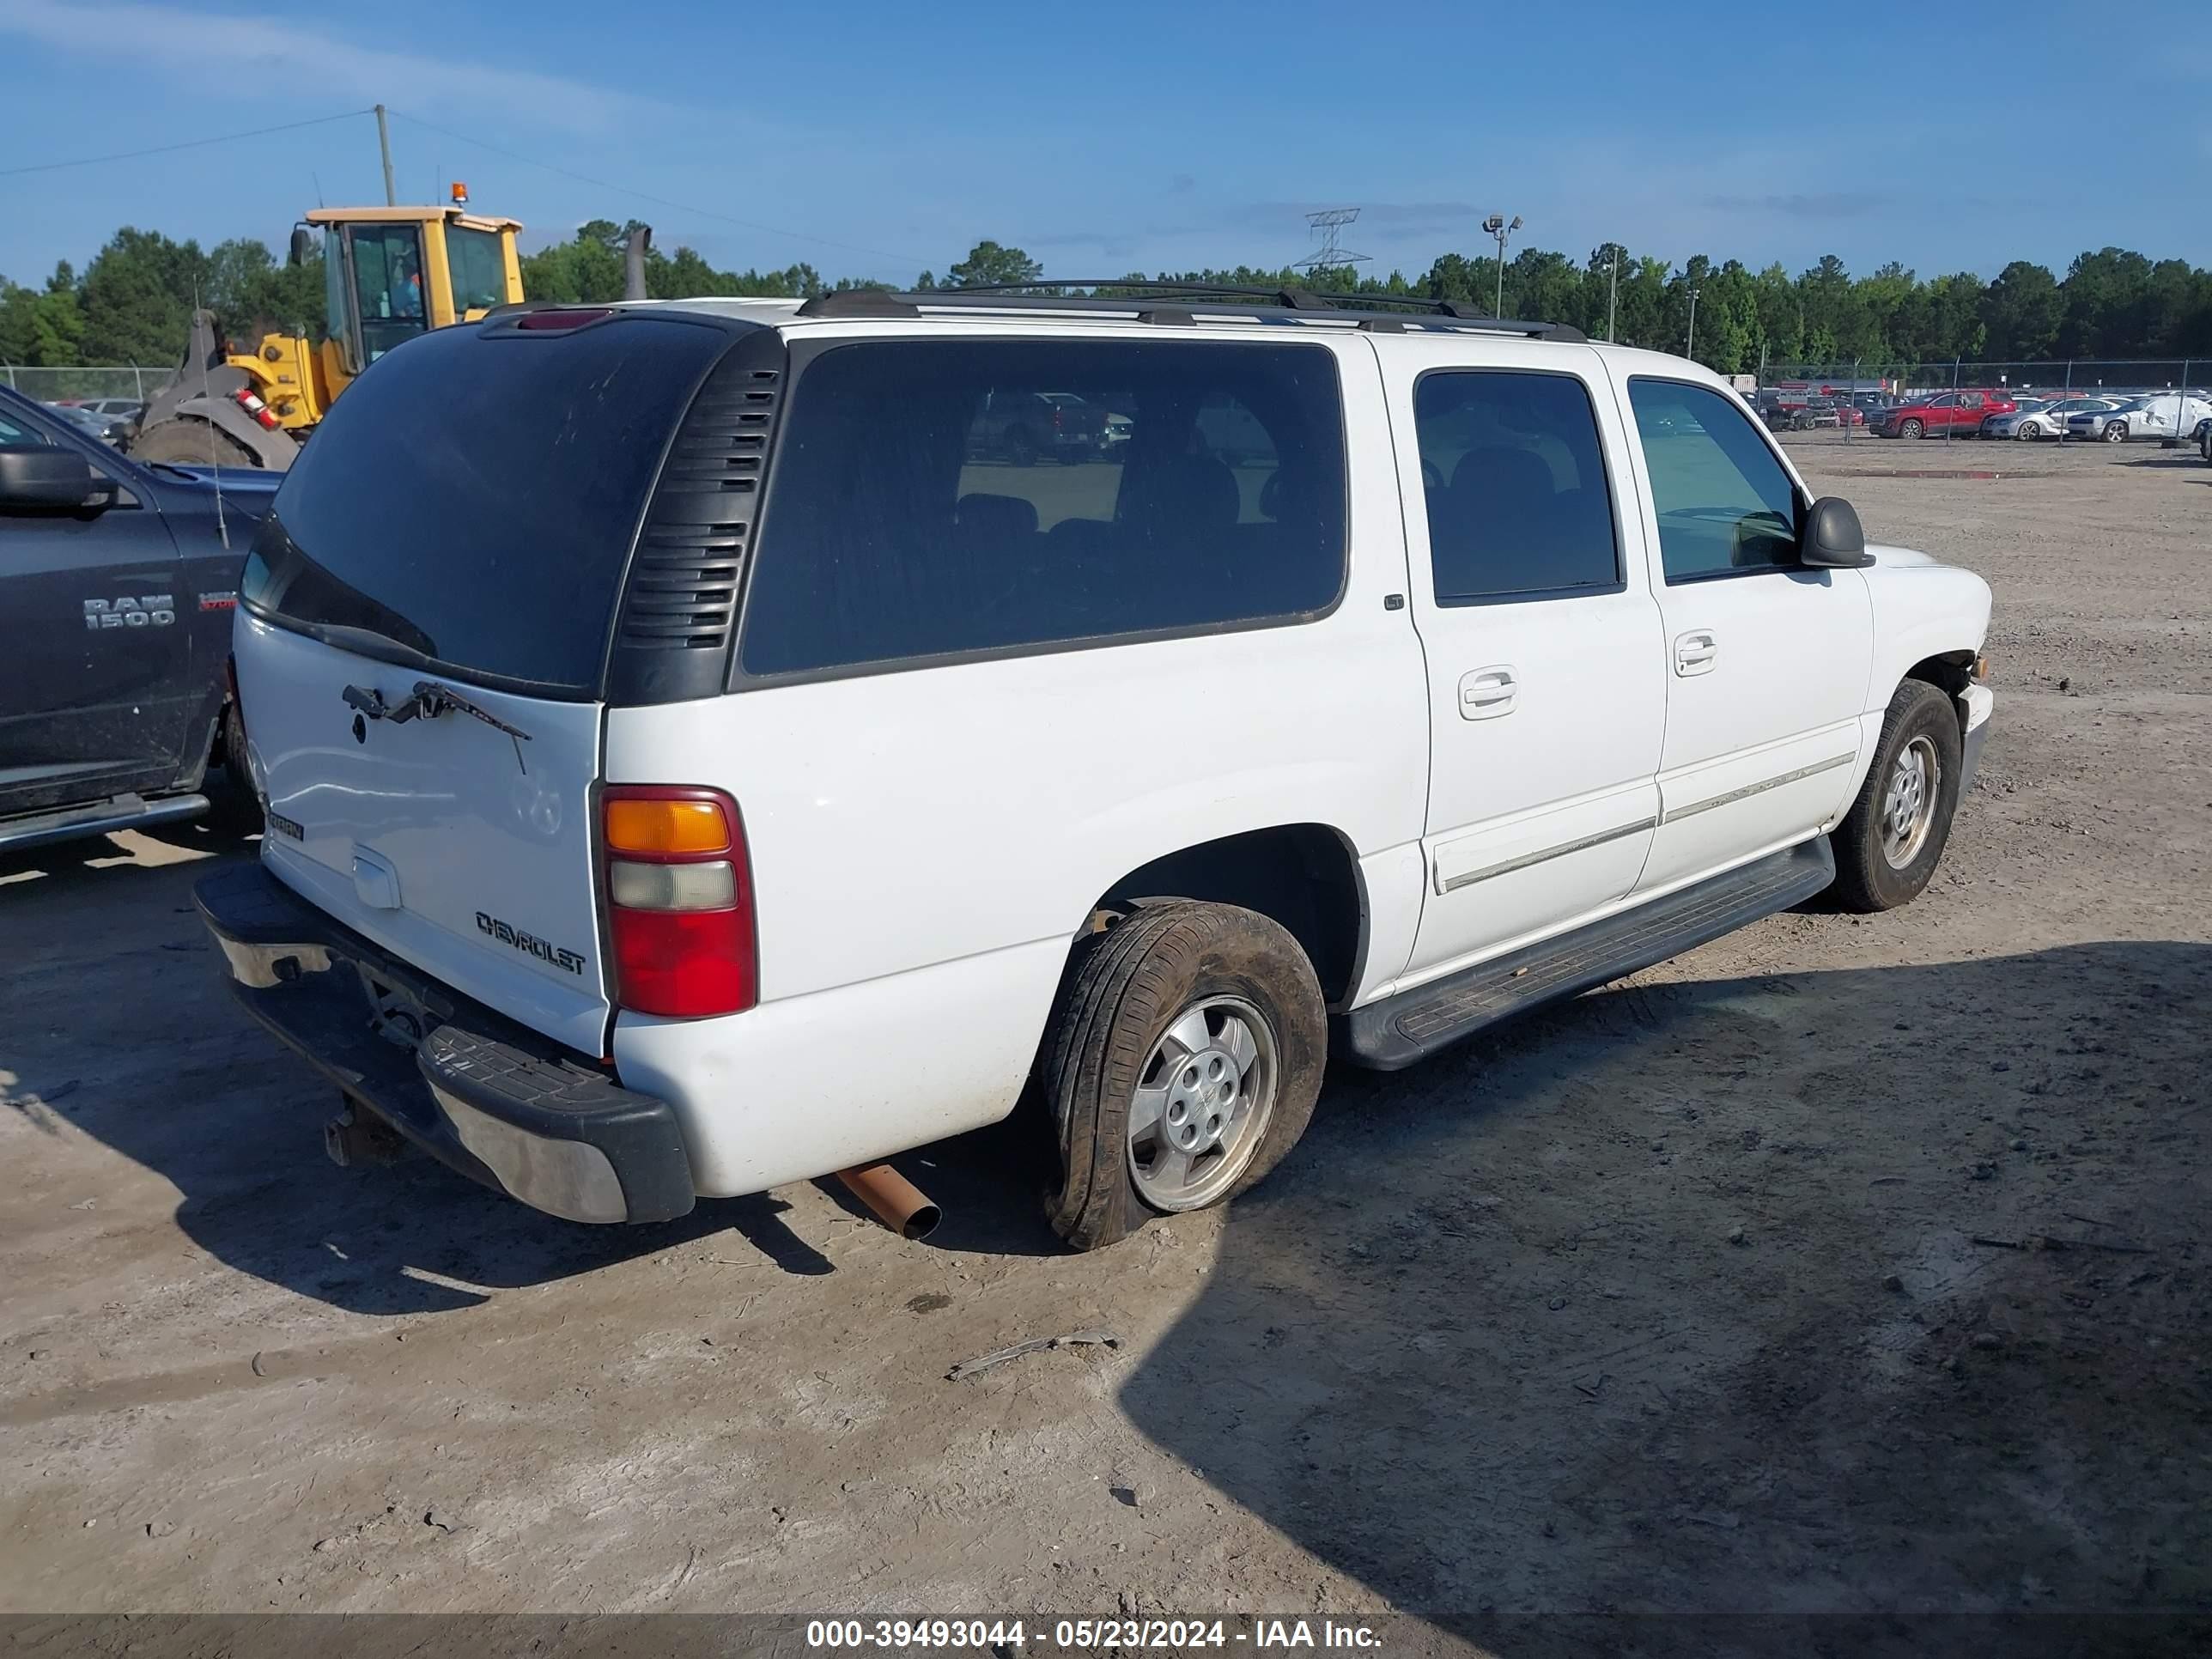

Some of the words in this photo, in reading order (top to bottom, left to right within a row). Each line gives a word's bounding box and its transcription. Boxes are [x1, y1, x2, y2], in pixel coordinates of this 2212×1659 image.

[84, 594, 173, 614] RAM
[1385, 596, 1402, 609] LT
[86, 611, 175, 629] 1500
[476, 911, 586, 975] CHEVROLET
